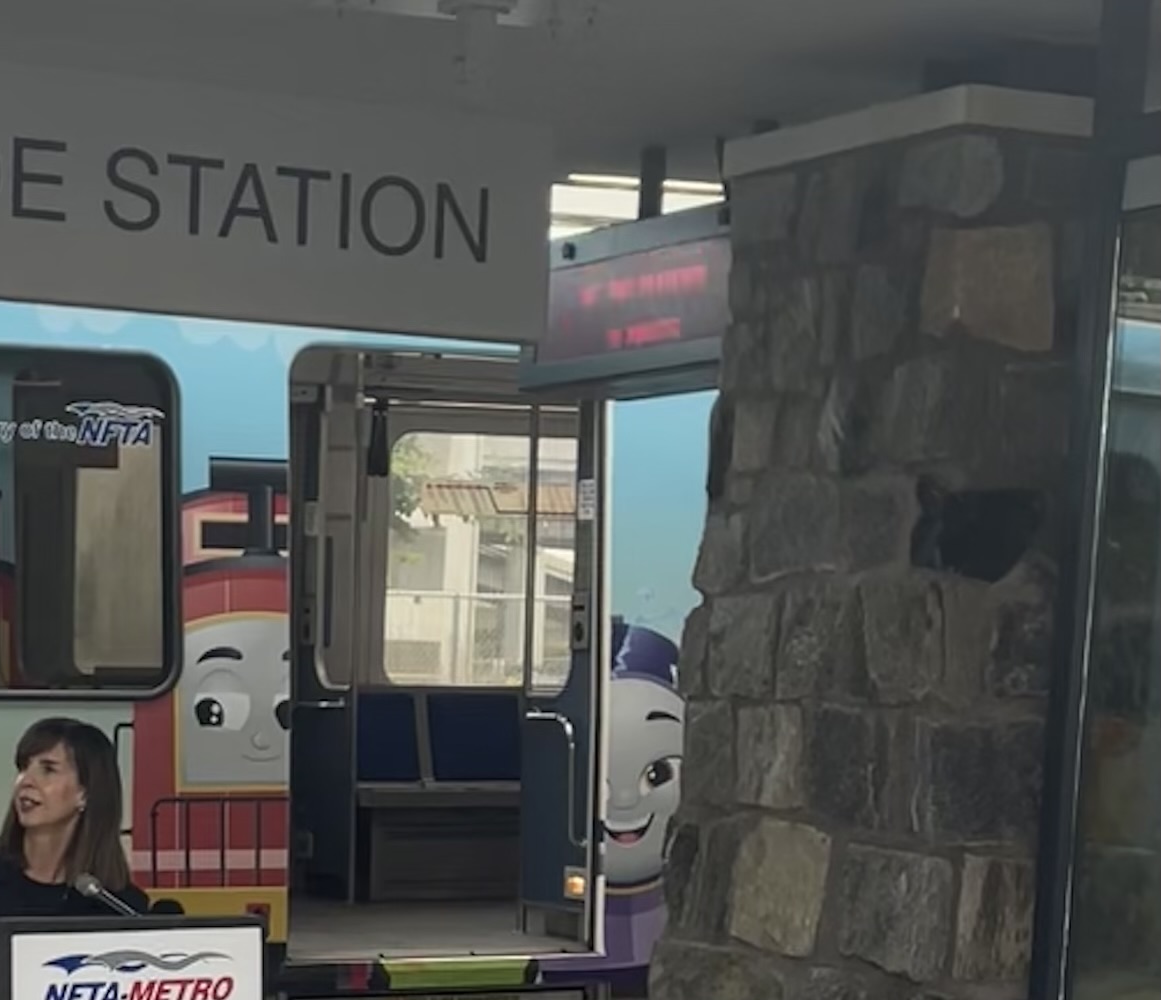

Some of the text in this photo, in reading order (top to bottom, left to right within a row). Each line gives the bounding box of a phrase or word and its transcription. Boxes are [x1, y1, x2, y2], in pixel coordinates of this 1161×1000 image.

[102, 147, 489, 264] STATION
[20, 418, 43, 439] of
[44, 420, 77, 441] the
[78, 417, 152, 445] NFTA
